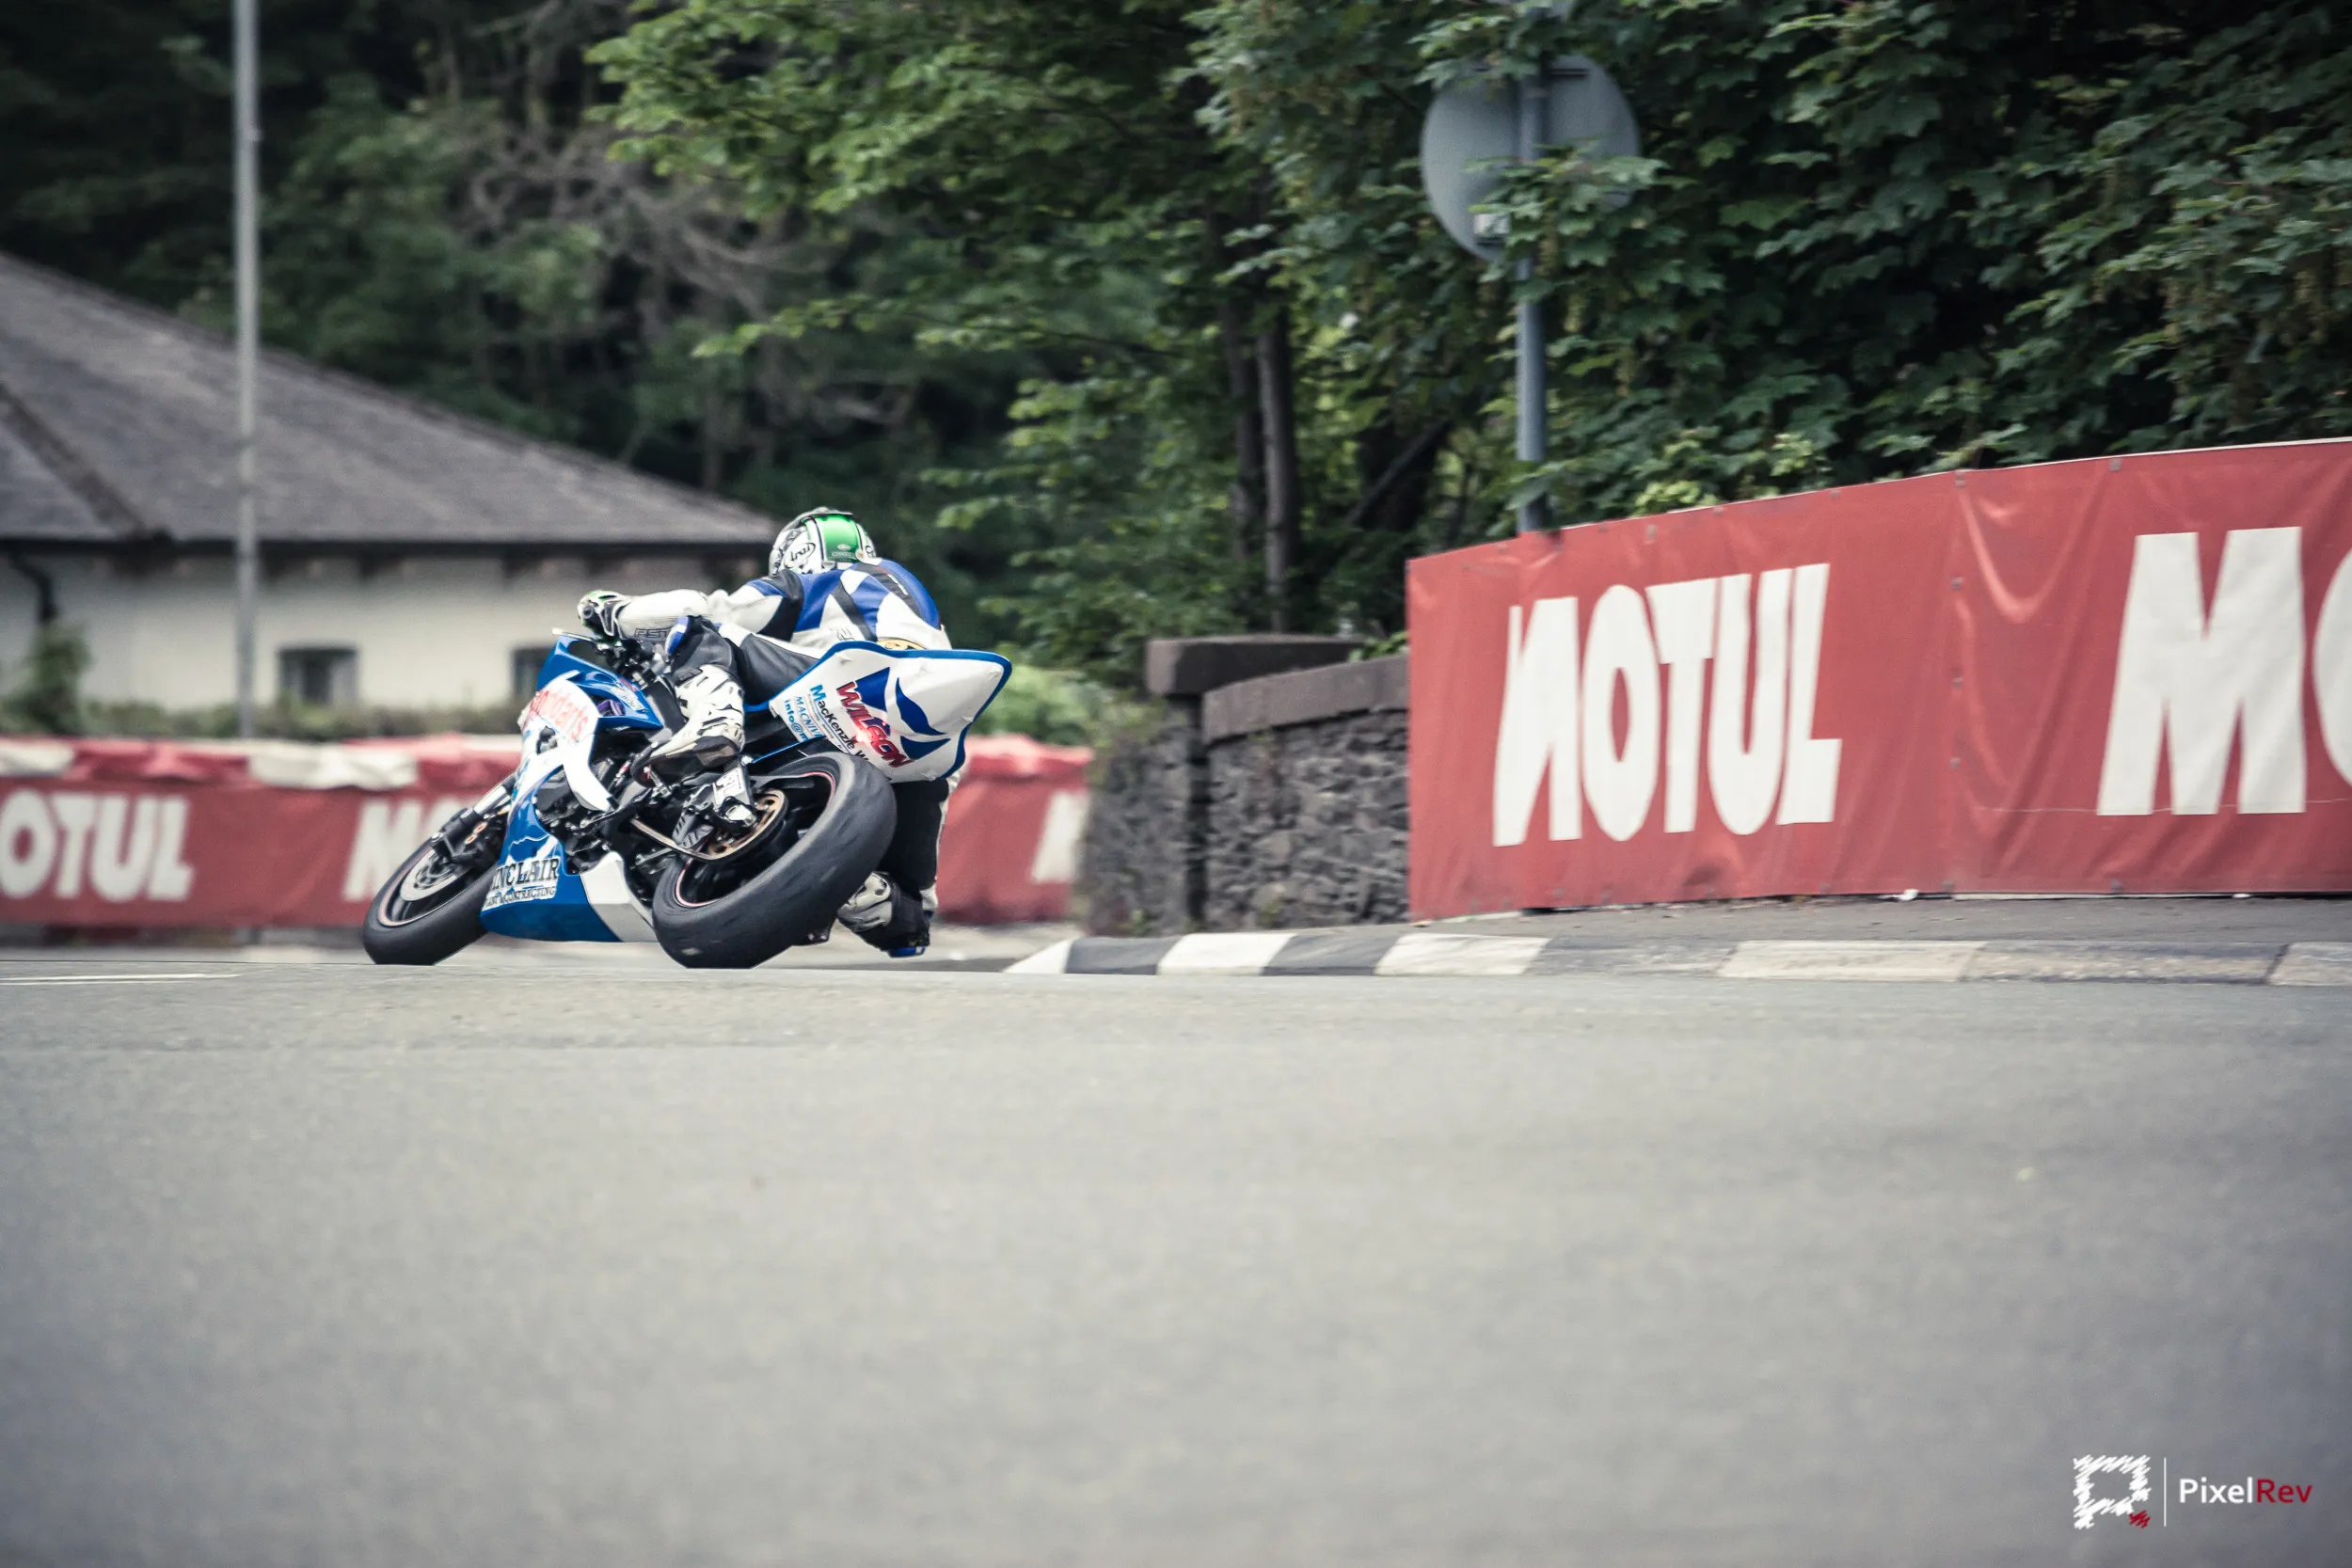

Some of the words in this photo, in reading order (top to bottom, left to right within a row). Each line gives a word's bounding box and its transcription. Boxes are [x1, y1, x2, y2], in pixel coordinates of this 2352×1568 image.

[810, 684, 855, 750] MacKenzie
[836, 680, 915, 768] WILSON
[1493, 562, 1842, 847] MOTUL
[0, 788, 195, 902] OTUL
